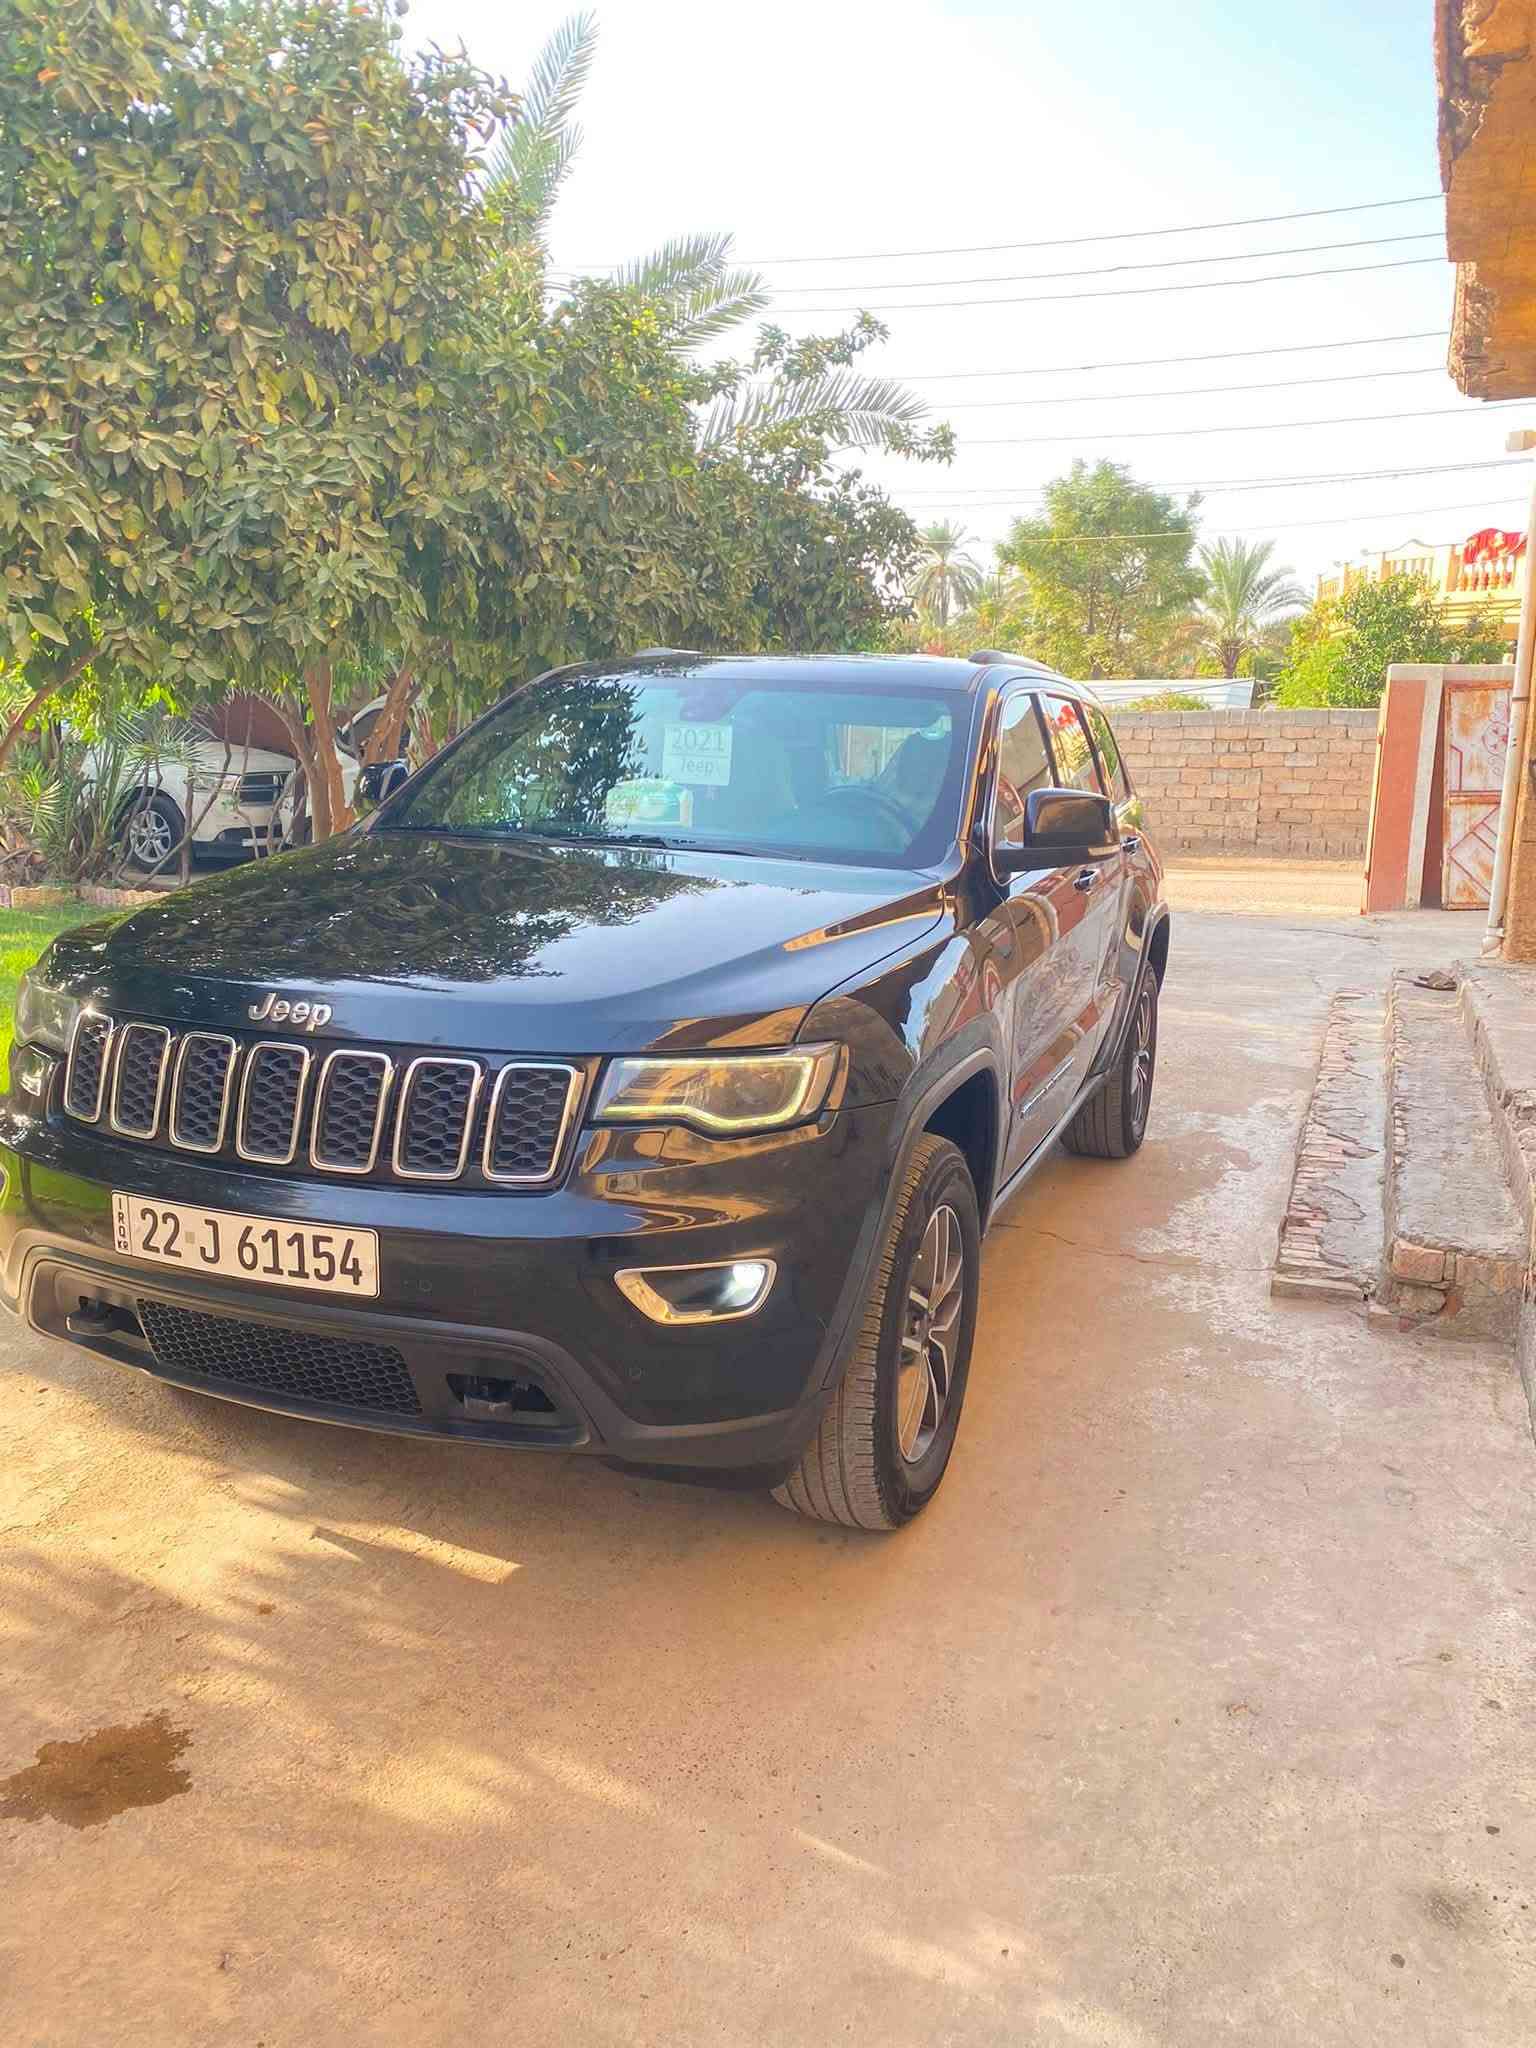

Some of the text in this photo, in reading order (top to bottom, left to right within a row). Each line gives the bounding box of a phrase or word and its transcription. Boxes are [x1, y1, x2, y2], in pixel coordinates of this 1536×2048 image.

[671, 727, 725, 752] 2021
[680, 757, 715, 777] Jeep
[248, 992, 332, 1032] Jeep
[117, 1197, 126, 1238] IRQ
[140, 1207, 362, 1286] 22 J 61154
